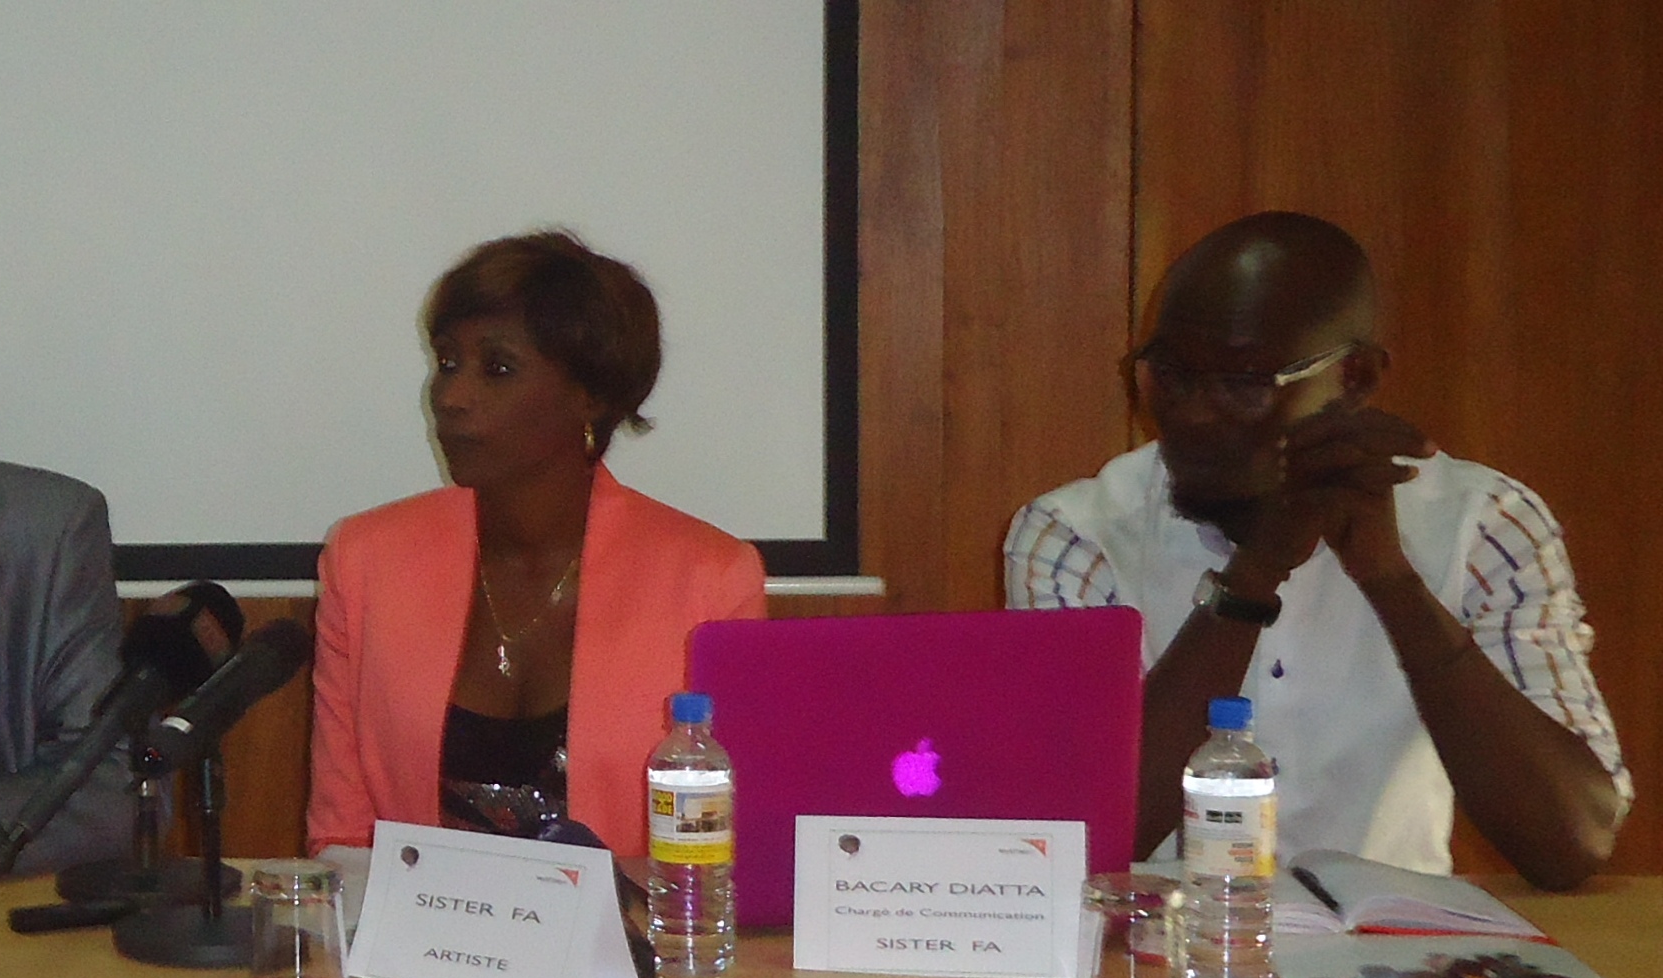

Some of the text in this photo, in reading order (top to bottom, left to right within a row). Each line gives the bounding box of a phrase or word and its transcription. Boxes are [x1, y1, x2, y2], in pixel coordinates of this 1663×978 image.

[835, 879, 1046, 898] BACARY DIATTA
[415, 892, 542, 925] SISTER FA
[895, 906, 914, 917] de
[919, 907, 1045, 921] Communication
[875, 937, 1002, 954] SISTER FA
[423, 947, 509, 972] ARTISTE
